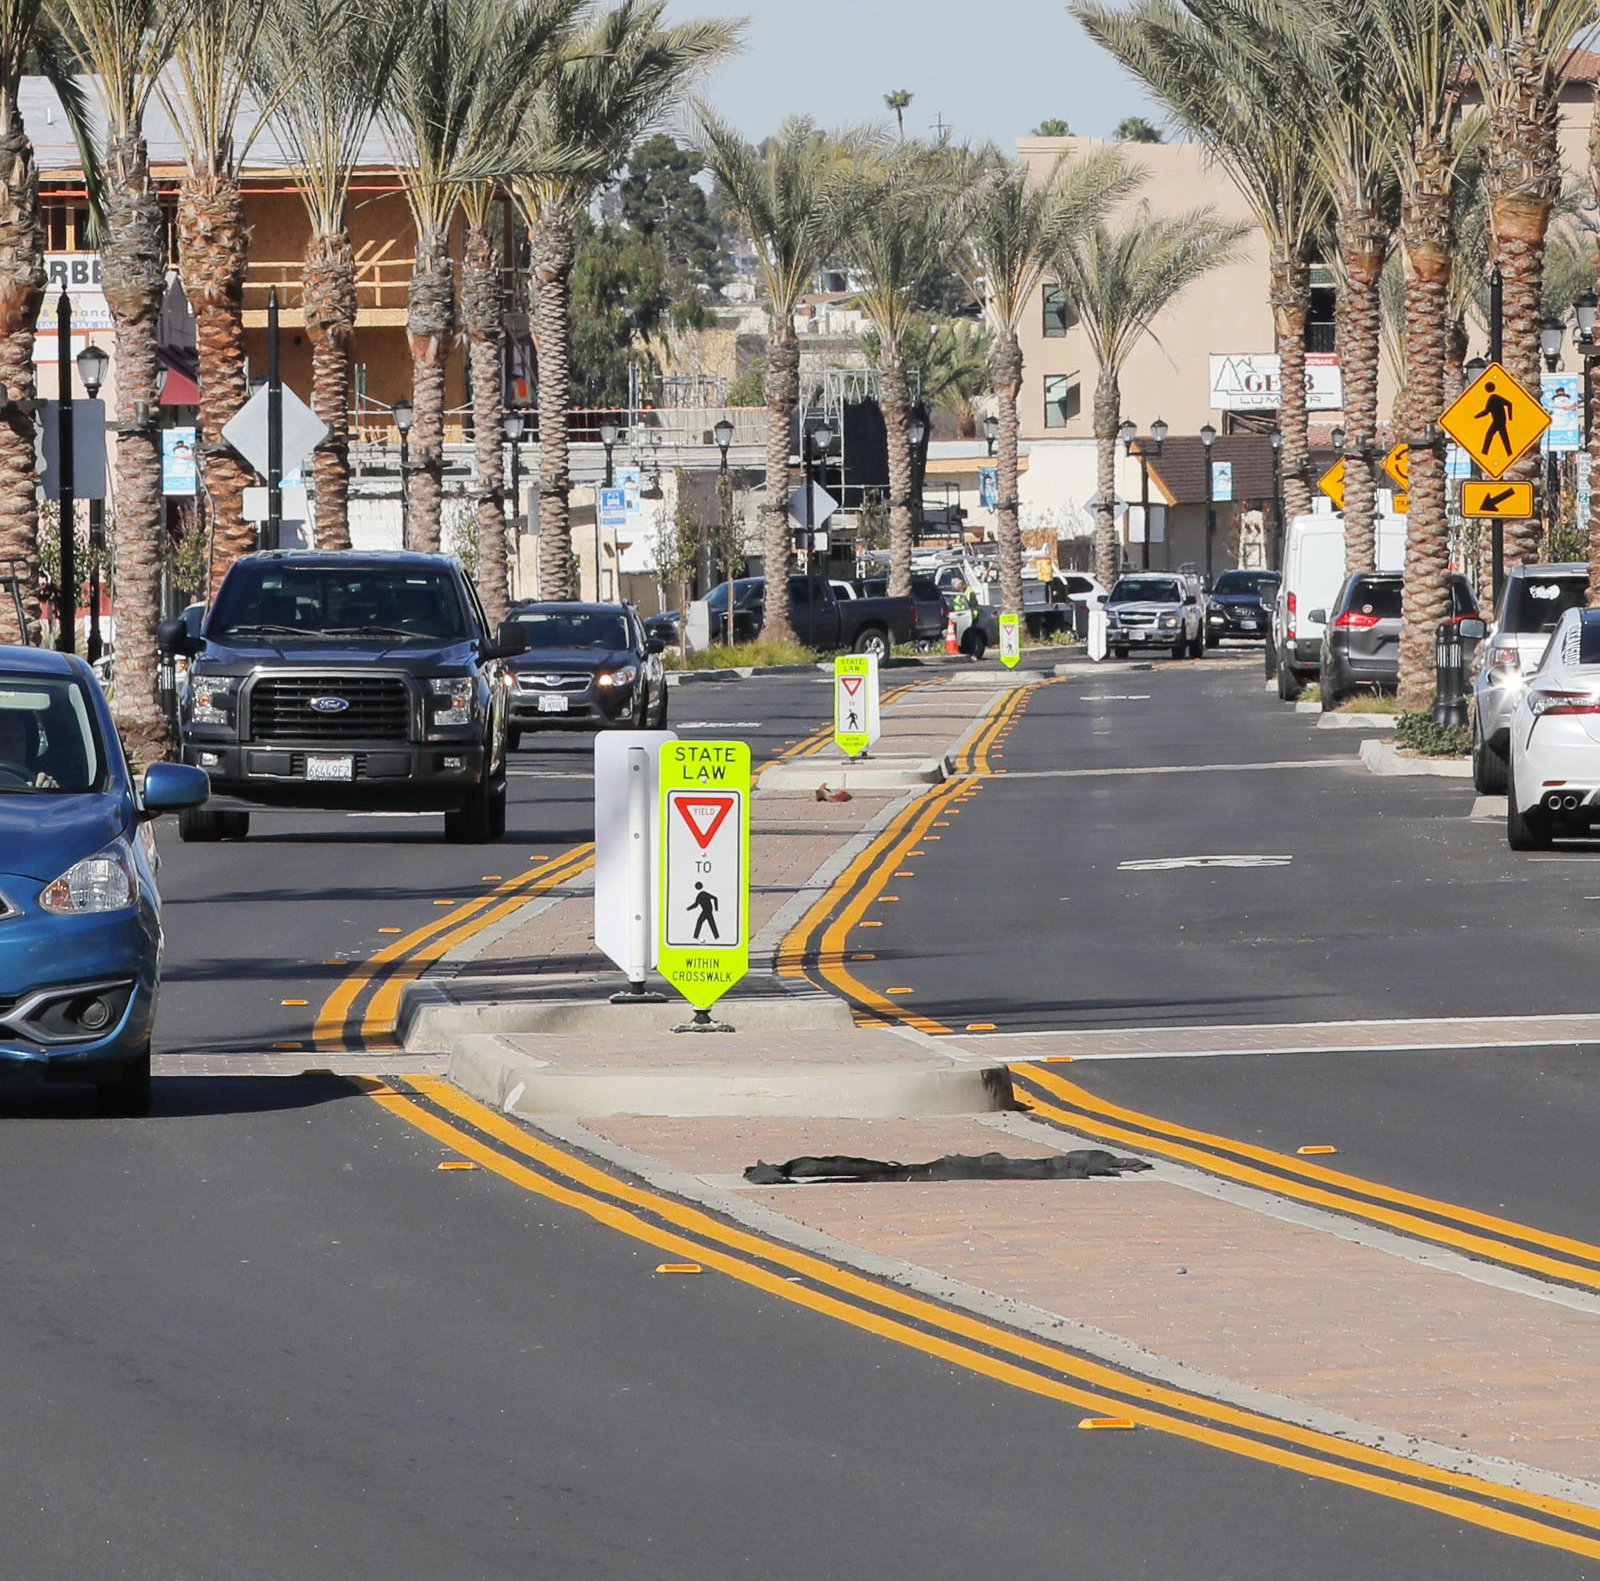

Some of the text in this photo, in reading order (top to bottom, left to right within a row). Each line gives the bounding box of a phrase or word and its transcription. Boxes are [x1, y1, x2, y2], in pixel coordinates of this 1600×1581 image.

[1240, 395, 1322, 404] LUMR
[674, 746, 737, 763] STATE
[682, 765, 727, 780] LAW
[693, 807, 716, 816] YIELD
[695, 861, 712, 874] TO
[685, 957, 720, 969] WITHIN
[671, 970, 732, 983] CROSSWALK
